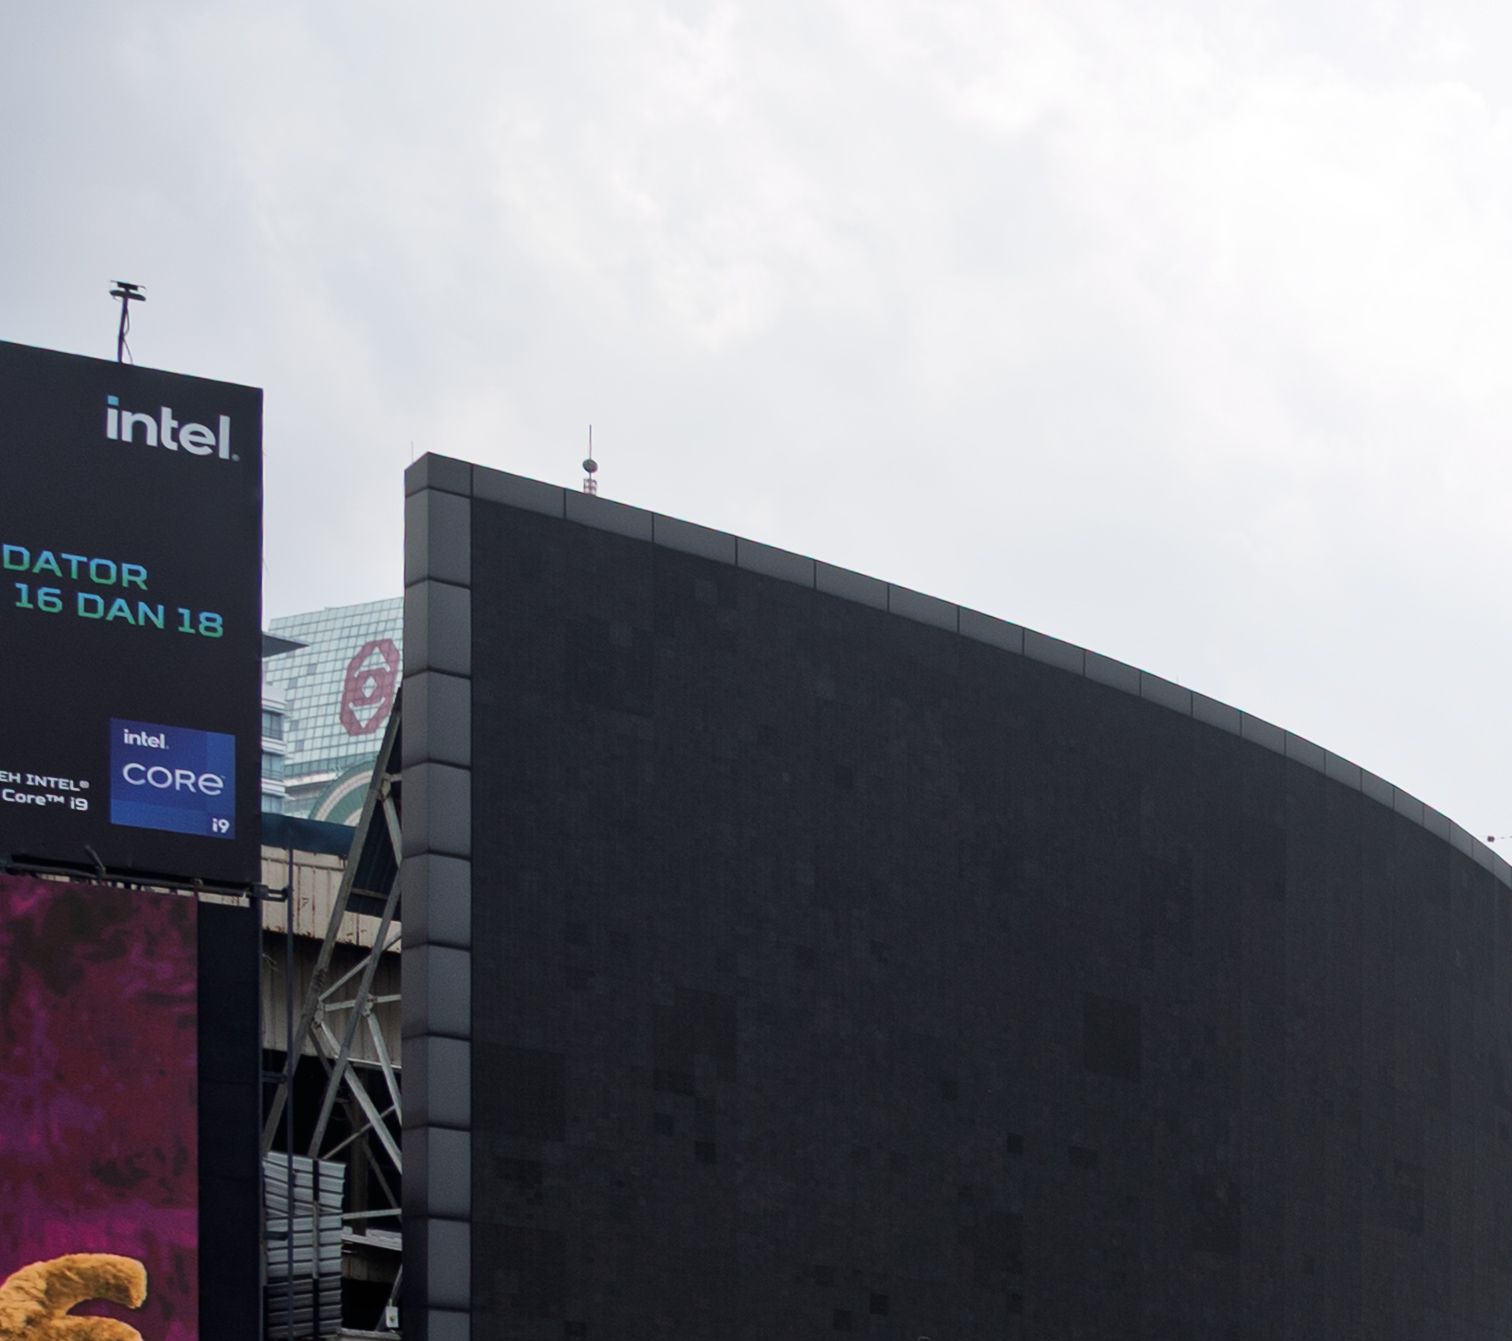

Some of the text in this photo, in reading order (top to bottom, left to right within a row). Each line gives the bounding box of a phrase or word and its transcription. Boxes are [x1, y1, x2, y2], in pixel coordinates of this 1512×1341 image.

[15, 581, 224, 638] 16 DAN 18
[70, 795, 89, 811] i9
[211, 817, 230, 834] i9
